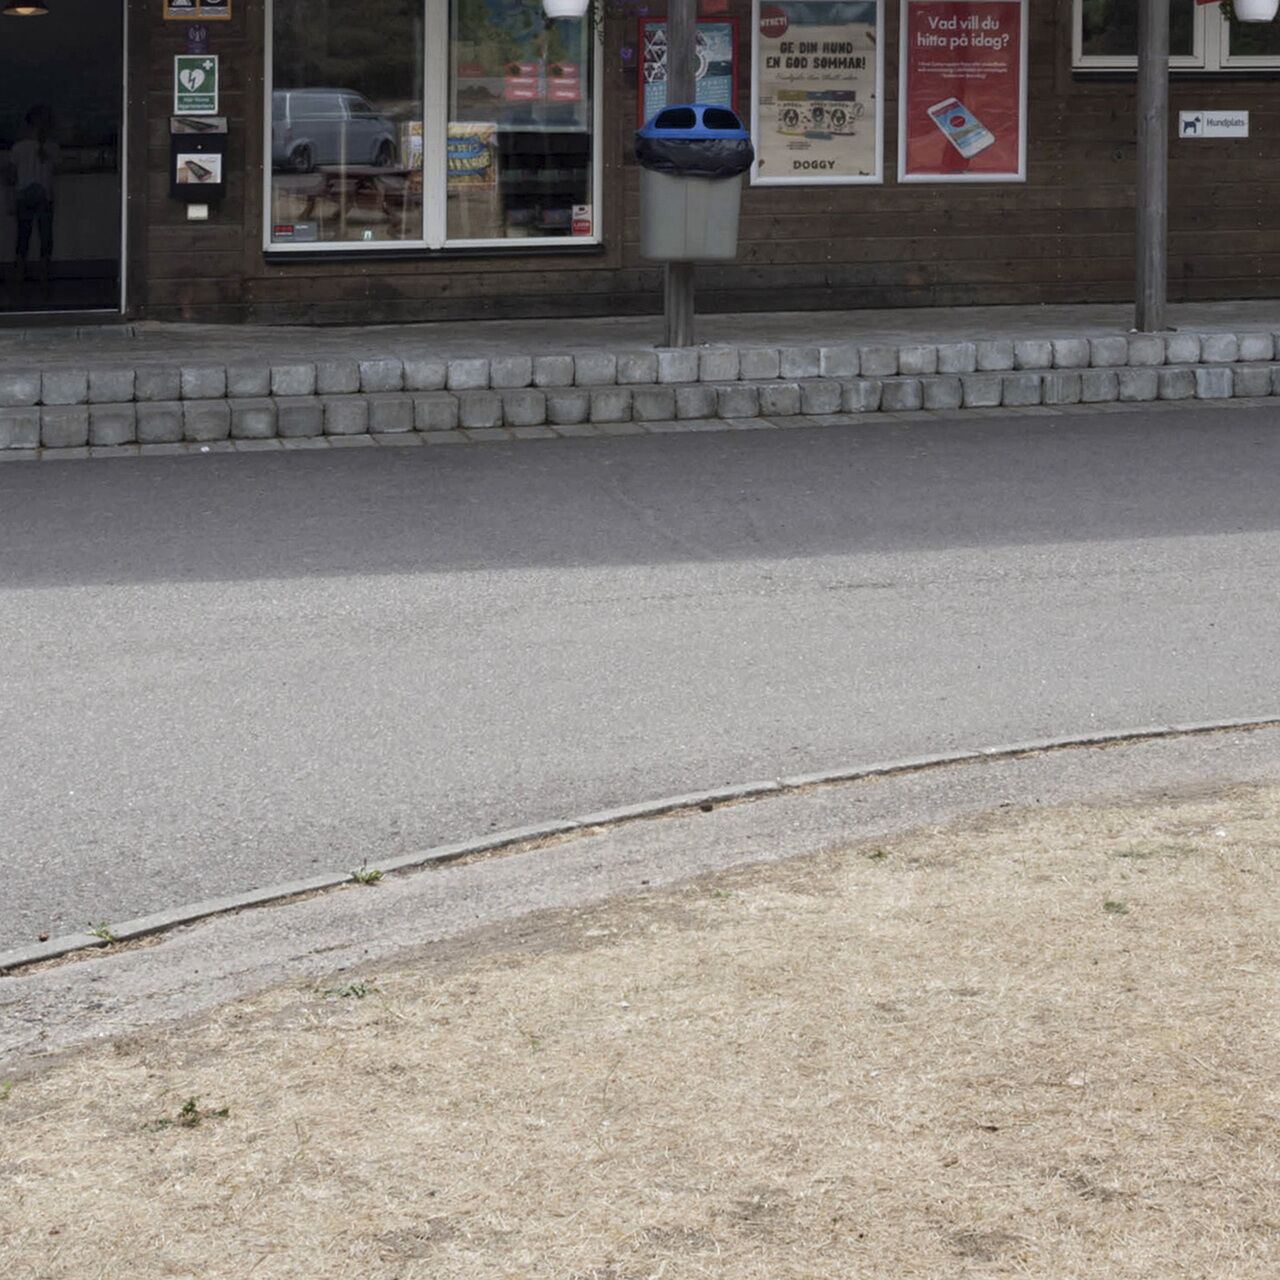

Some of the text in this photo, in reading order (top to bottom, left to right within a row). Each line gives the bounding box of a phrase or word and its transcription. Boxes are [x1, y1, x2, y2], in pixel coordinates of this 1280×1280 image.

[928, 15, 1000, 30] Vad vill du
[917, 32, 1010, 50] hitta på idag?
[780, 42, 853, 54] GE DIN HUND
[766, 57, 866, 70] EN GOD SOMMAR!
[793, 160, 835, 170] DOGGY
